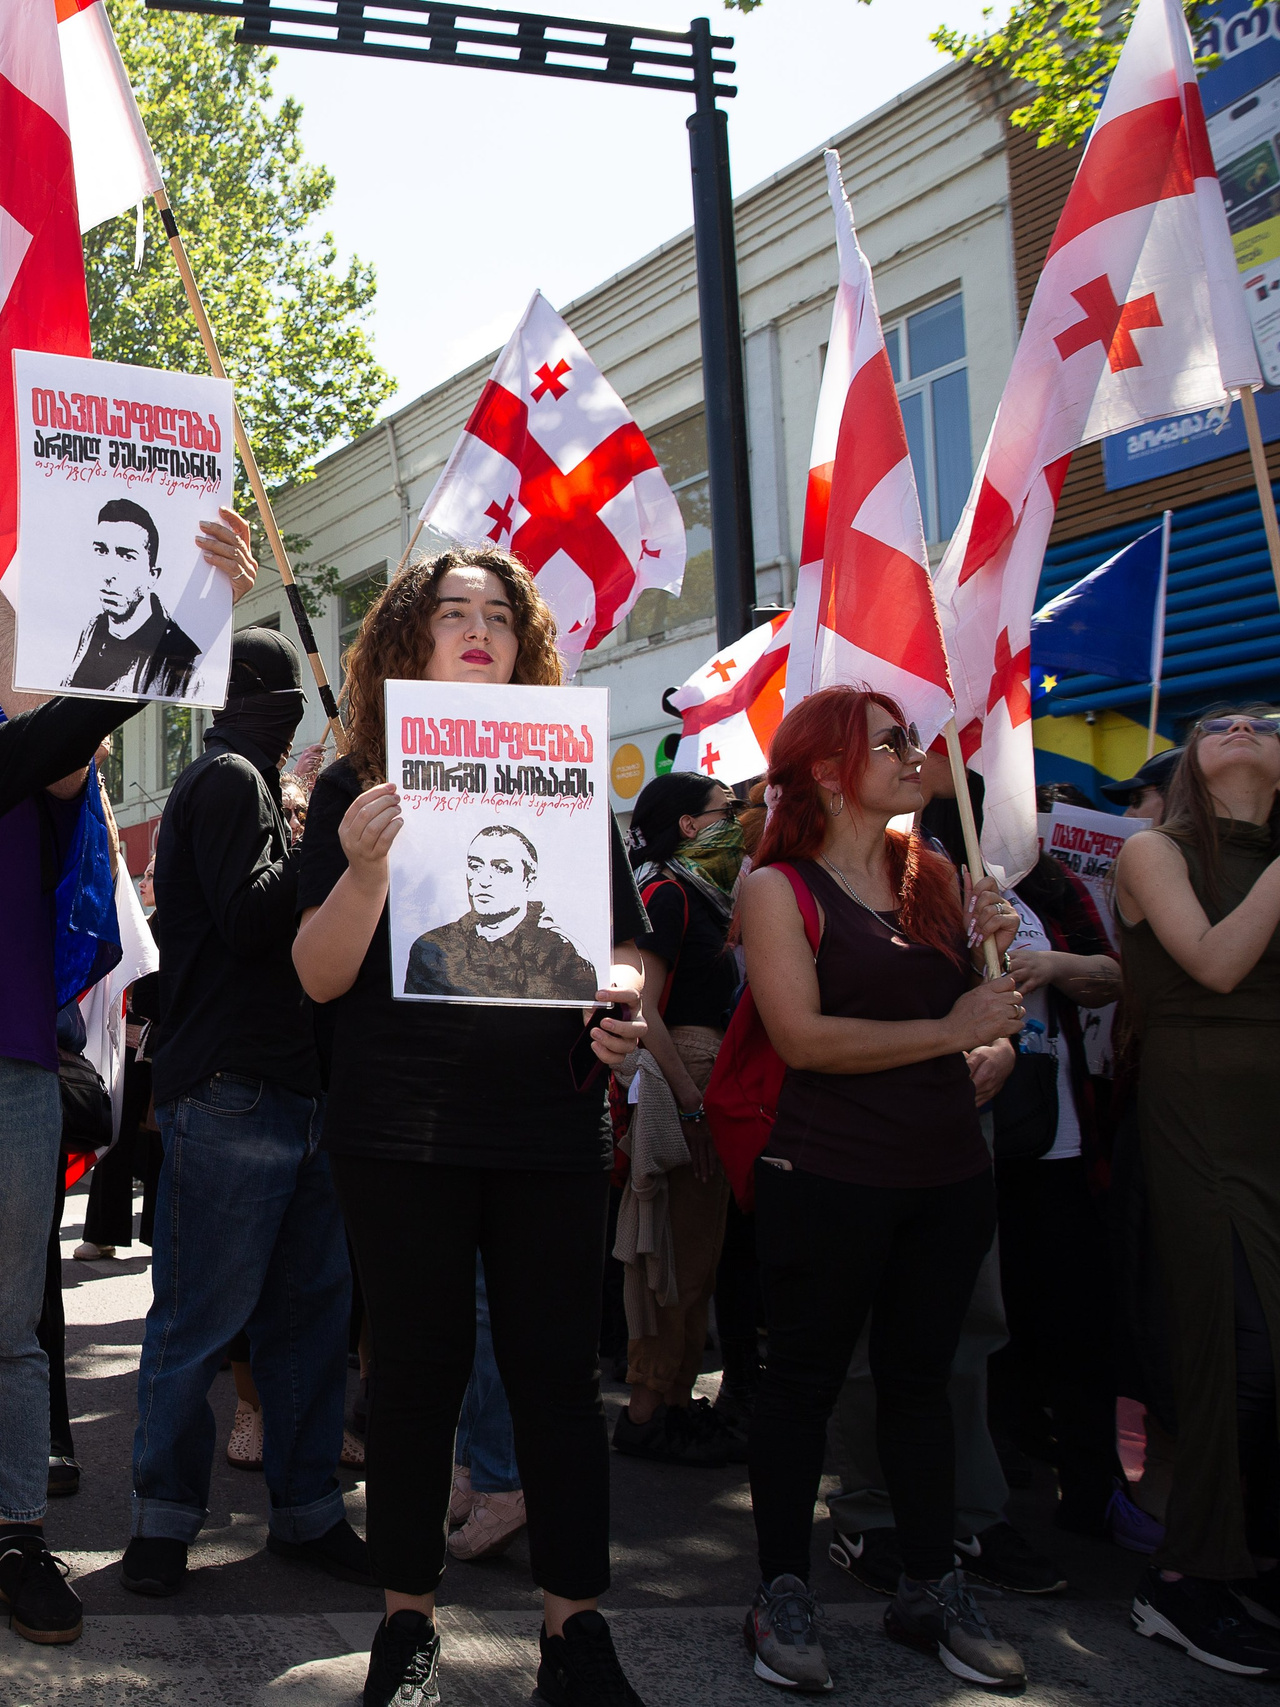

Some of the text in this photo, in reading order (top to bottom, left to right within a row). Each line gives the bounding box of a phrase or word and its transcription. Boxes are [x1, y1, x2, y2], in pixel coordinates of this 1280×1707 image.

[31, 387, 221, 453] თავისუფლება
[33, 429, 102, 464] არჩილ
[401, 716, 594, 764] თავისუფლება
[402, 759, 487, 794] გიორგი
